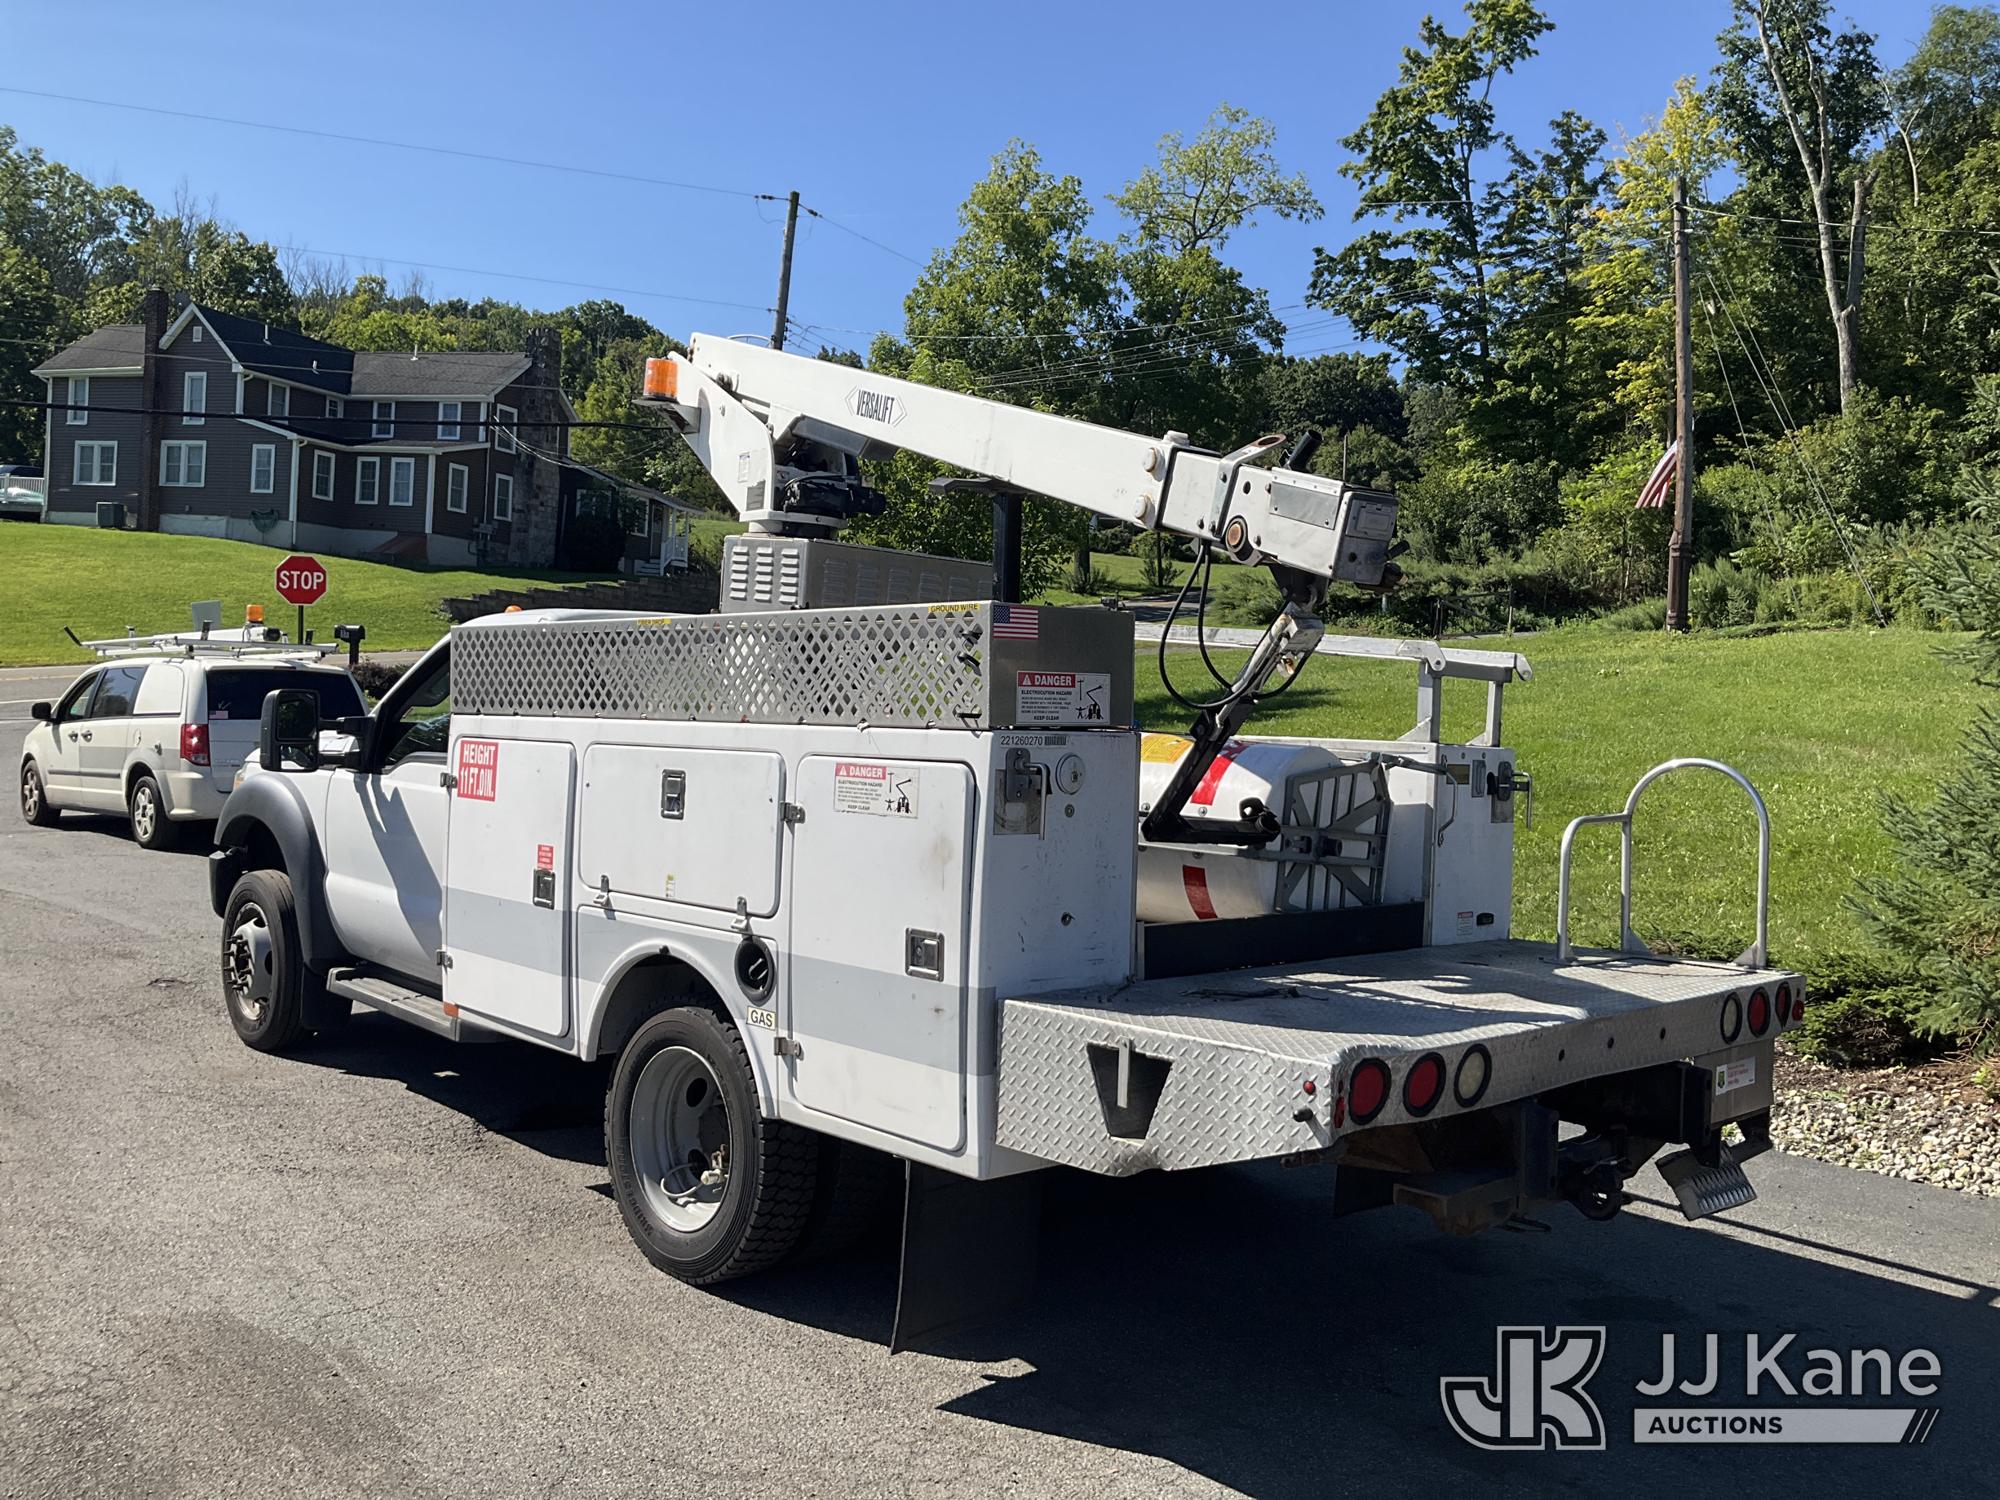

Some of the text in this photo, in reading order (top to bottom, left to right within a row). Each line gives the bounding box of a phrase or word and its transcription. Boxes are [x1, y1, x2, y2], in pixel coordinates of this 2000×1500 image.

[856, 389, 895, 424] VERSALIFT
[279, 570, 324, 590] STOP
[931, 604, 959, 612] GROUND
[1034, 674, 1072, 687] DANGER
[1001, 735, 1043, 746] 221260270
[463, 743, 496, 766] HEIGHT
[849, 765, 883, 778] DANGER
[750, 1009, 773, 1027] GAS
